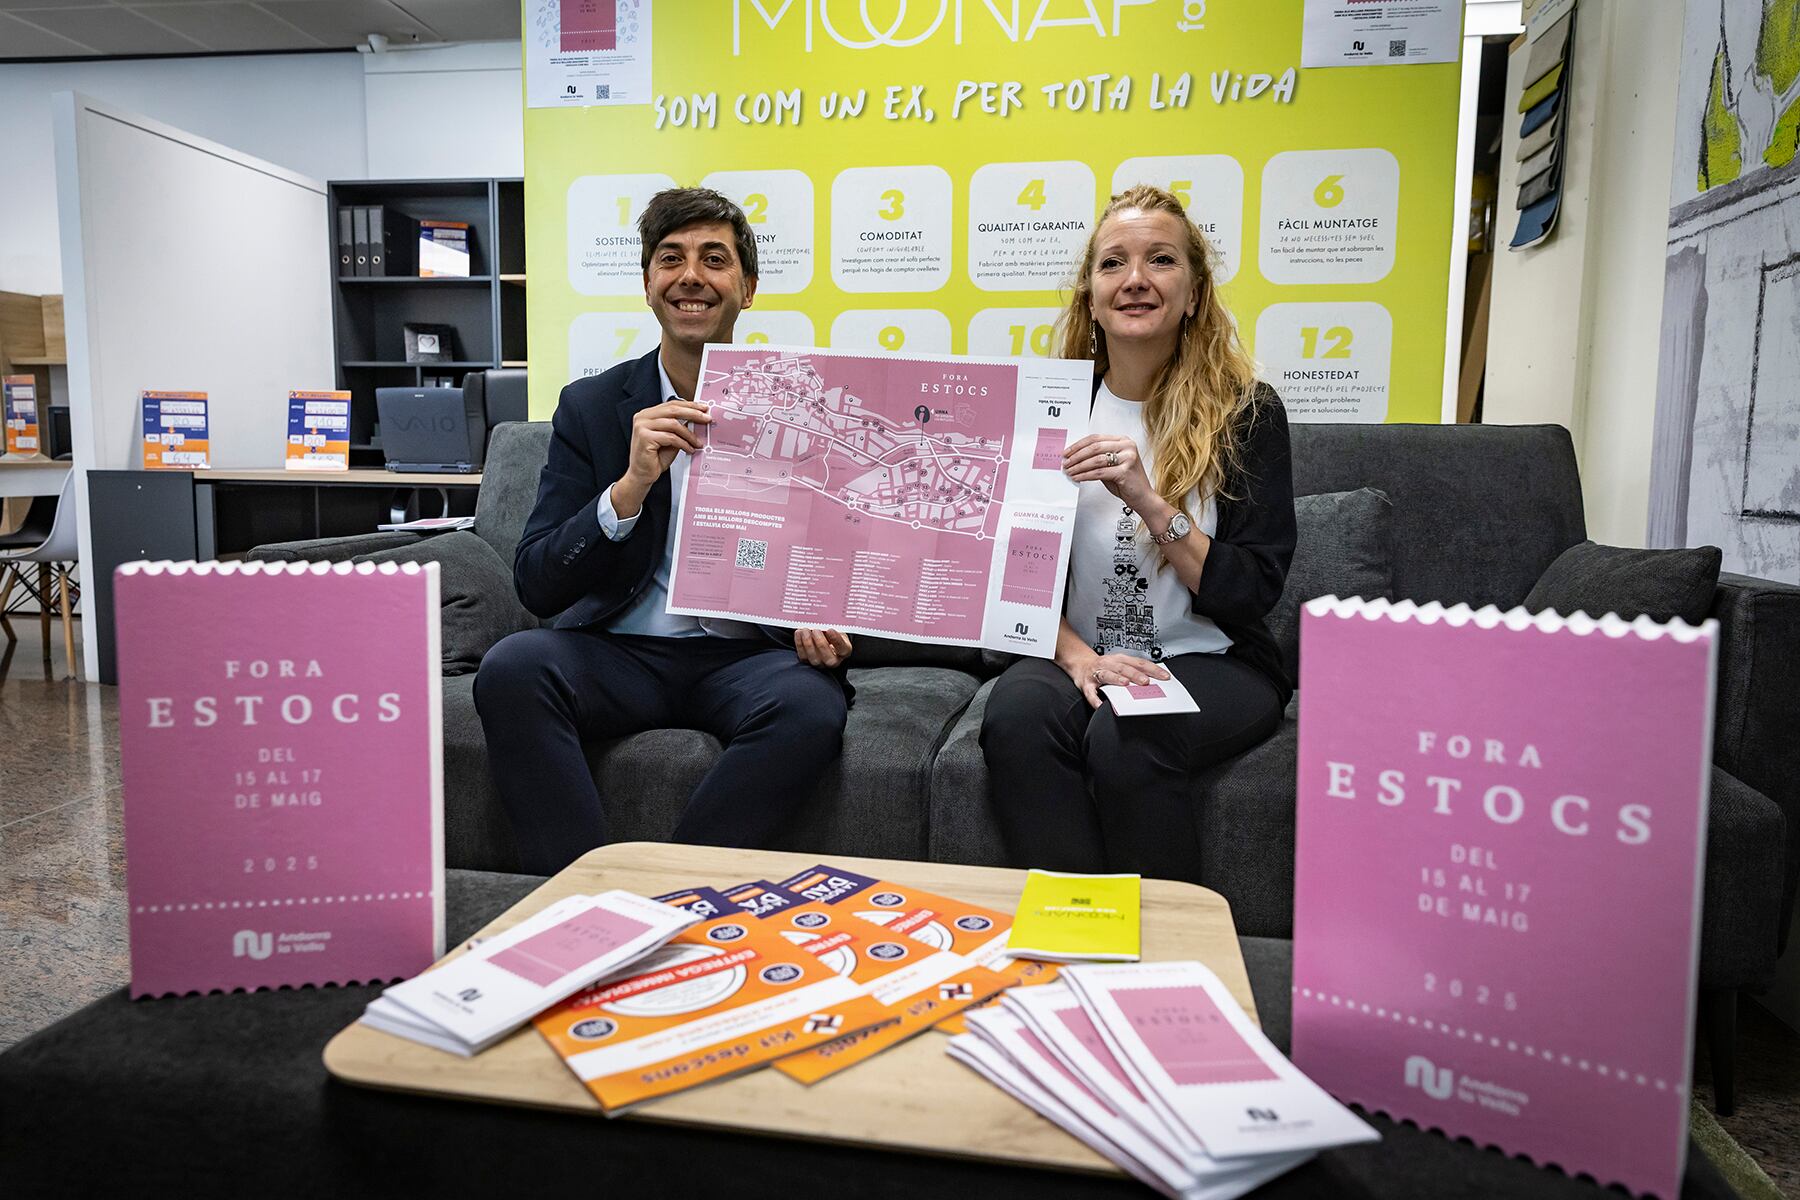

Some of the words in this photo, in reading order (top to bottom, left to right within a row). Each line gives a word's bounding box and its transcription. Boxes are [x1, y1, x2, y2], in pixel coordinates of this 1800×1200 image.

[655, 92, 717, 130] SOM
[735, 87, 802, 127] COM
[819, 89, 867, 119] UN
[884, 84, 935, 123] EX,
[953, 80, 1023, 120] PER
[1041, 73, 1134, 115] TOTA
[1150, 72, 1191, 110] LA
[1017, 179, 1046, 211] 4
[1169, 181, 1192, 210] 5
[1313, 175, 1345, 208] 6
[616, 197, 632, 226] 1
[743, 193, 769, 224] 2
[878, 189, 905, 221] 3
[978, 223, 1025, 232] QUALITAT
[1027, 223, 1030, 231] I
[1033, 221, 1085, 231] GARANTIA
[1278, 218, 1309, 230] FÀCIL
[1313, 218, 1378, 229] MUNTATGE
[860, 231, 923, 241] COMODITAT
[614, 329, 640, 357] 7
[1301, 326, 1354, 359] 12
[942, 373, 968, 382] FORA
[1283, 371, 1360, 380] HONESTEDAT
[920, 383, 989, 396] ESTOCS
[1330, 396, 1361, 404] problema
[718, 515, 743, 523] MILLORS
[725, 508, 750, 517] MILLORS
[750, 512, 785, 522] PRODUCTES
[1013, 511, 1039, 519] GUANYA
[1011, 549, 1055, 561] ESTOCS
[226, 660, 323, 679] FORA
[147, 692, 402, 728] ESTOCS
[258, 748, 297, 763] DEL
[1418, 731, 1542, 769] FORA
[235, 772, 256, 787] 15
[267, 770, 289, 785] AL
[302, 769, 322, 784] 17
[235, 794, 260, 809] DE
[271, 791, 322, 807] MAIG
[1326, 761, 1653, 845] ESTOCS
[244, 856, 318, 874] 2025
[1451, 844, 1498, 870] DEL
[1422, 867, 1446, 889] 15
[1459, 875, 1488, 898] AL
[1505, 882, 1531, 902] 17
[1418, 893, 1449, 917] DE
[1462, 902, 1529, 933] MAIG
[1424, 972, 1518, 1011] 2025
